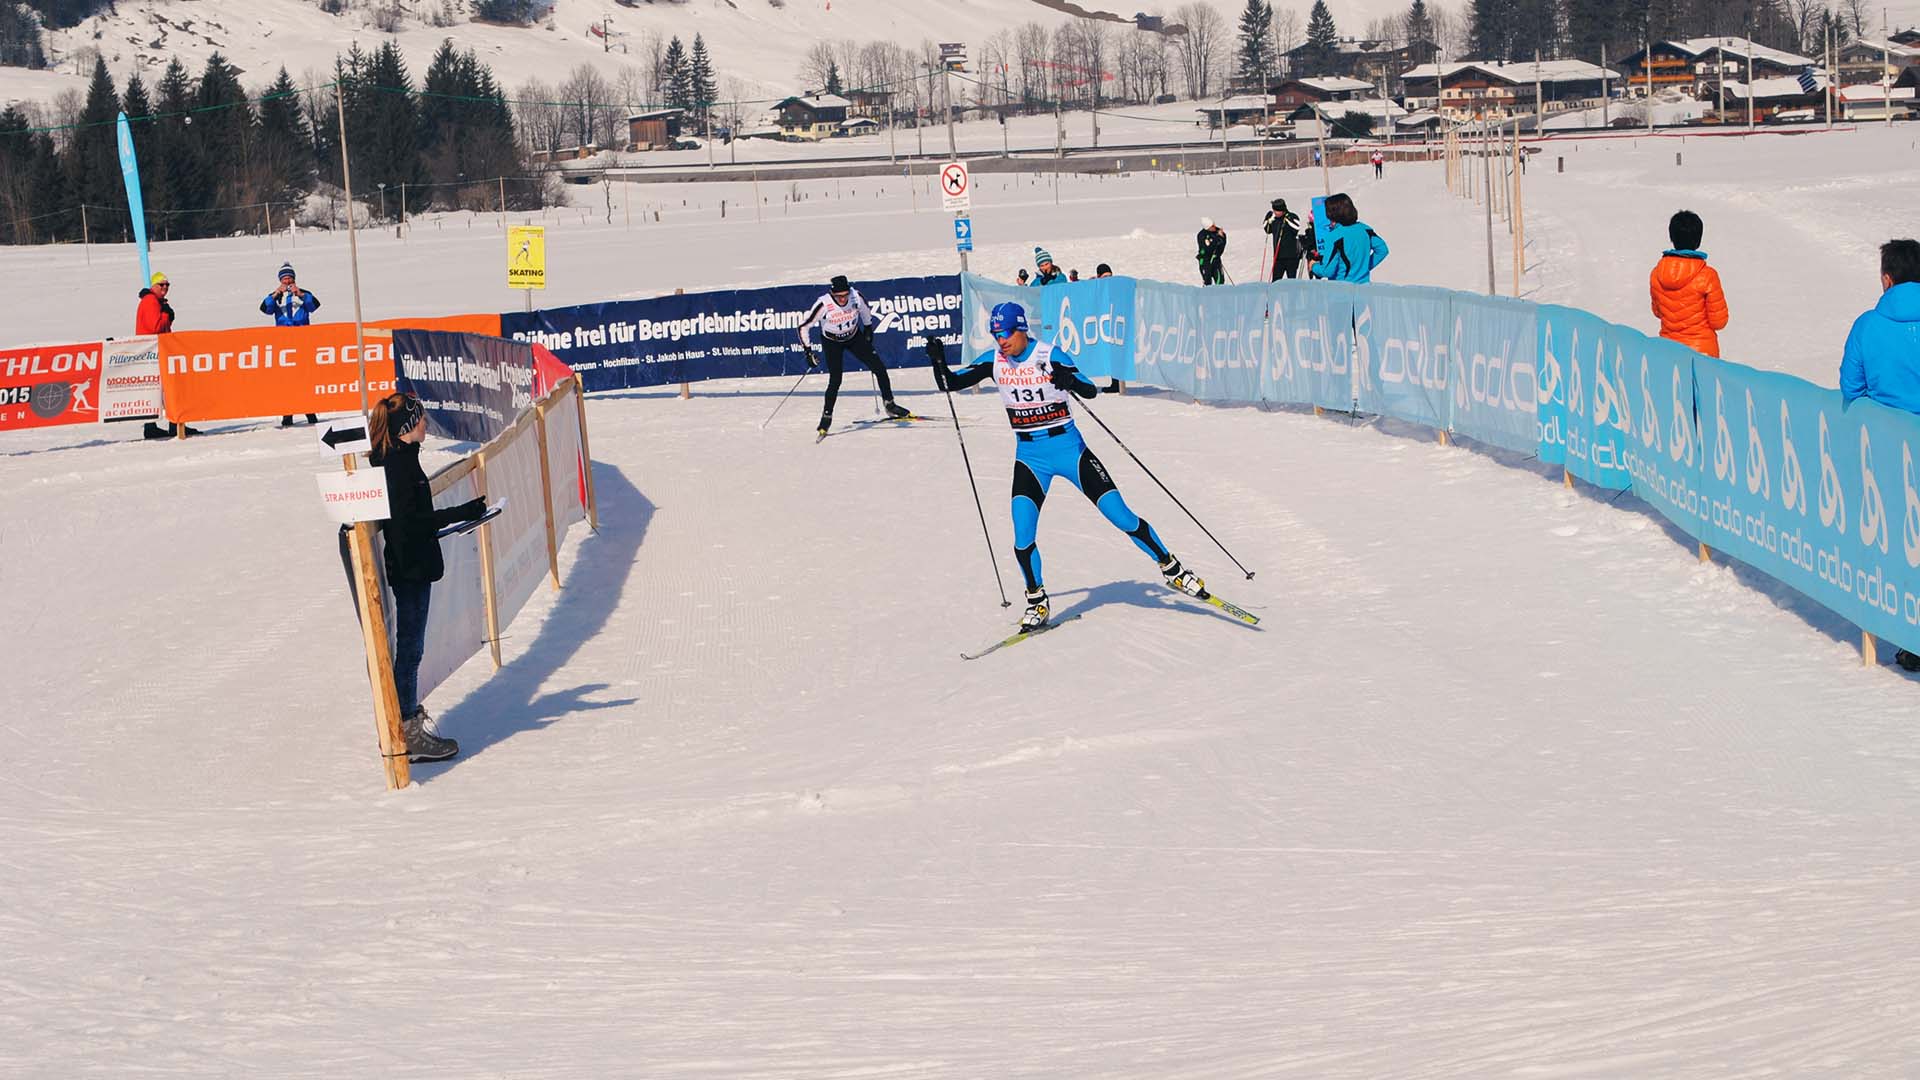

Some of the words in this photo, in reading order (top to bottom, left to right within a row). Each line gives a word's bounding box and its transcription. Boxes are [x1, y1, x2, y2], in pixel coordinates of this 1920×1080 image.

[509, 269, 544, 277] SKATING
[574, 325, 606, 348] frei
[609, 321, 637, 344] für
[168, 345, 296, 374] nordic
[603, 358, 640, 368] Hochfilzen
[657, 352, 677, 363] Jakob
[686, 349, 705, 360] Haus
[753, 345, 785, 355] Pillersee
[1379, 323, 1448, 390] odlo
[1001, 367, 1035, 376] VOLKS
[1472, 339, 1538, 413] odlo
[107, 375, 160, 385] MONOLITH
[999, 374, 1053, 386] BIATHLON
[1011, 388, 1046, 402] 131
[113, 400, 152, 409] nordic
[1015, 405, 1056, 417] nordic
[105, 408, 160, 417] academy
[325, 489, 383, 502] STRAFRUNDE
[1713, 496, 1742, 536] odlo
[1746, 512, 1777, 553] odlo
[1781, 528, 1814, 573] odlo
[1818, 544, 1853, 593] odlo
[1857, 565, 1898, 616] odlo
[1904, 592, 1920, 626] o
